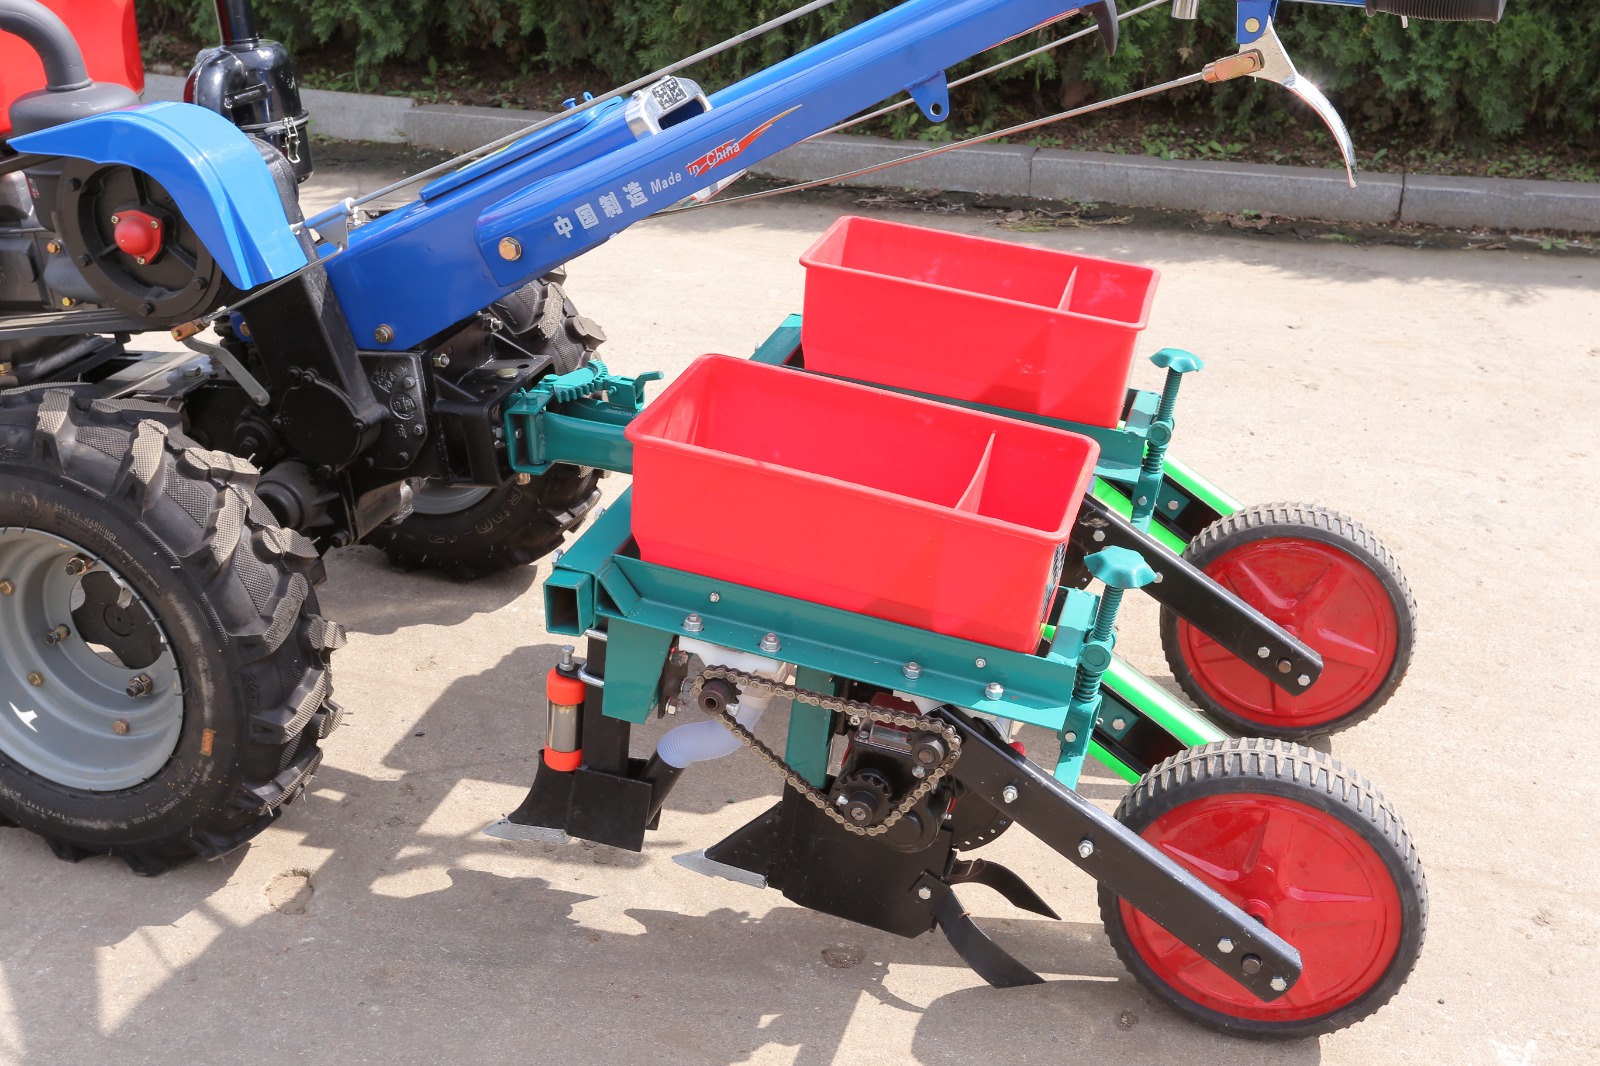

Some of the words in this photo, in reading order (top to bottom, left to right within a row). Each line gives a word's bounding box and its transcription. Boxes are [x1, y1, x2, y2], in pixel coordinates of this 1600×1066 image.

[649, 171, 682, 194] Made
[687, 162, 700, 176] in
[706, 142, 740, 166] China
[553, 181, 648, 239] 中国制造
